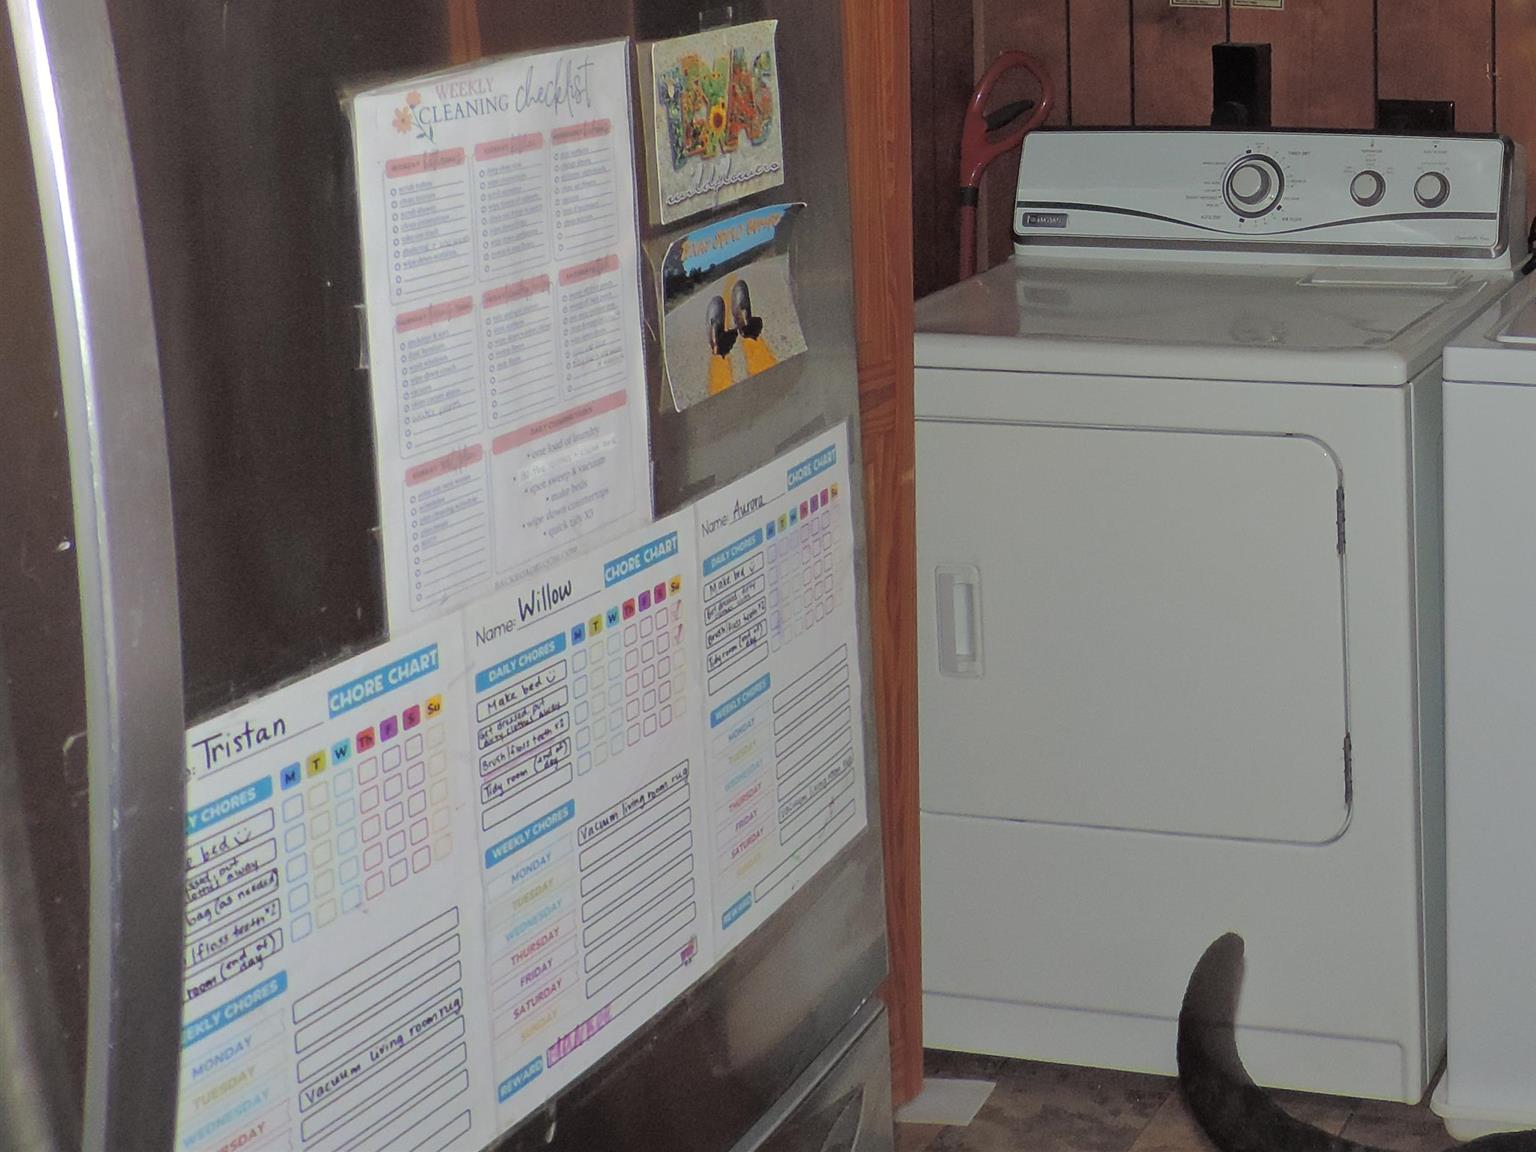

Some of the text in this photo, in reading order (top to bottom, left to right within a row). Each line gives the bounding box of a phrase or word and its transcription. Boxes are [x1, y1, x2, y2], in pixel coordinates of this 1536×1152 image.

[418, 54, 596, 127] CLEANING checklist
[434, 76, 496, 101] WEEKLY
[546, 505, 567, 521] down
[732, 494, 765, 521] Aurora
[605, 552, 641, 583] CHORE
[643, 535, 678, 565] CHART
[517, 579, 573, 623] Willow
[709, 576, 731, 594] Make
[475, 617, 518, 647] Name:
[329, 648, 440, 713] CHORE CHART
[487, 640, 556, 684] DAILY CHORES
[486, 675, 543, 716] Make bed
[191, 717, 287, 770] Tristan
[483, 781, 505, 799] Tidy
[506, 768, 529, 787] room
[200, 785, 258, 824] CHORES
[580, 811, 620, 841] Vacuum
[621, 793, 646, 817] living
[199, 835, 231, 864] bed
[490, 805, 571, 860] WEEKLY CHORES
[510, 851, 553, 885] MONDAY
[239, 952, 266, 972] day
[510, 926, 561, 966] THURSDAY
[519, 957, 554, 988] FRIDAY
[223, 978, 280, 1021] CHORES
[512, 976, 564, 1021] SATURDAY
[191, 1034, 253, 1080] MONDAY
[304, 997, 463, 1105] Vacuum living room rug
